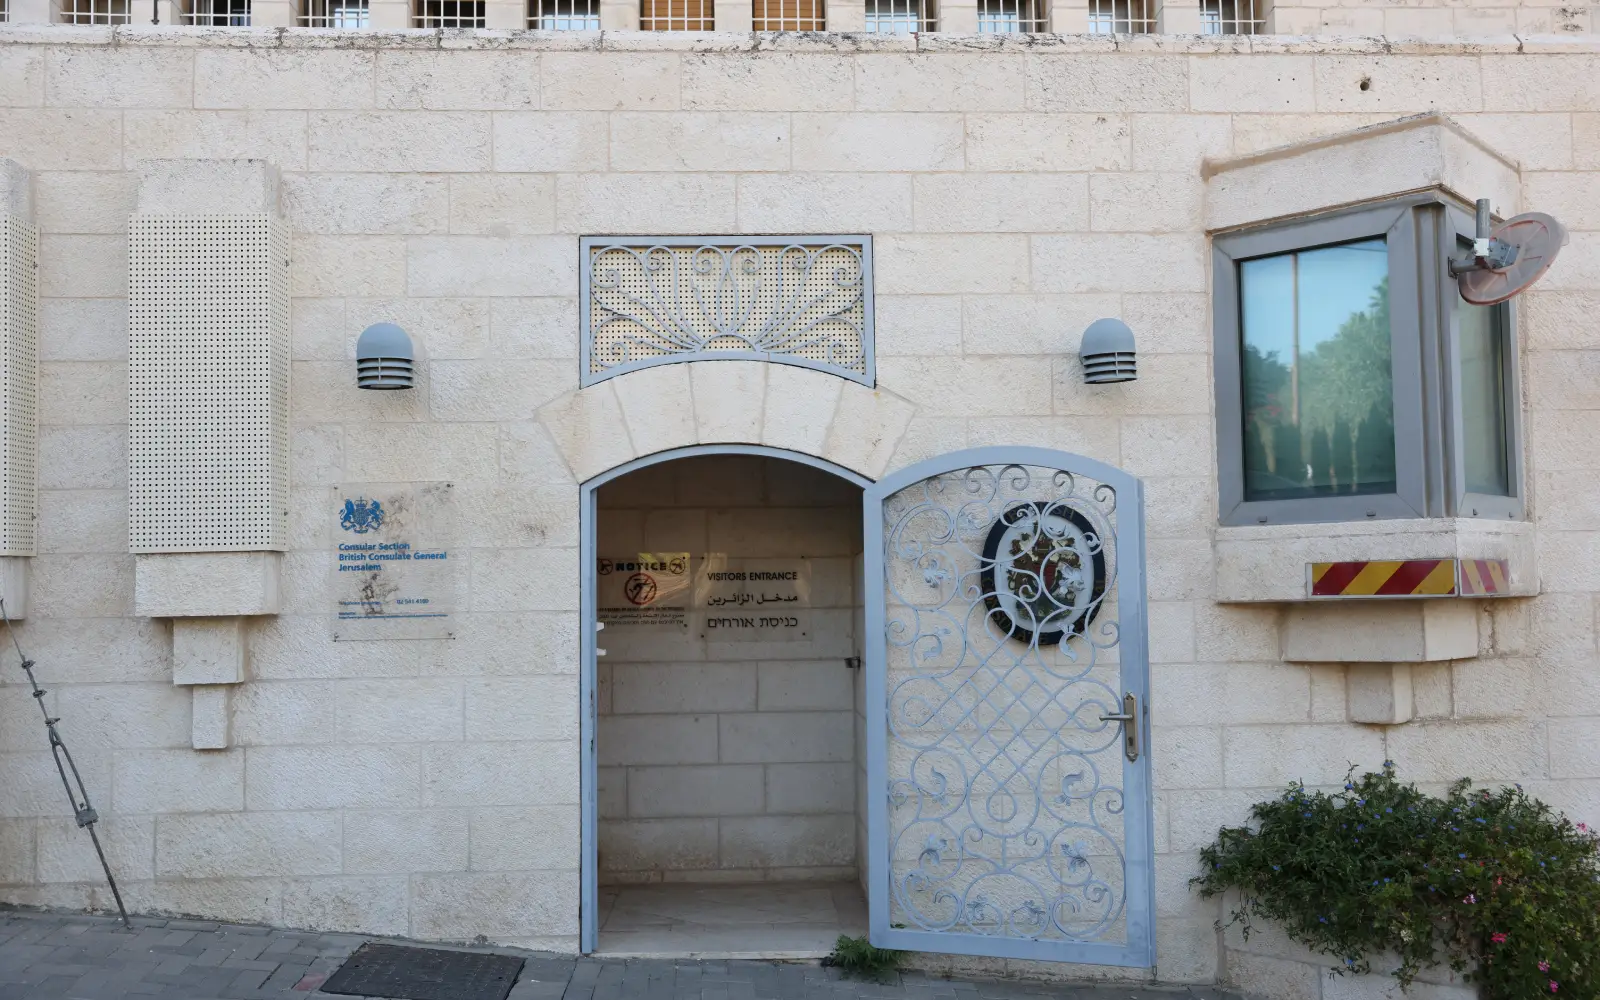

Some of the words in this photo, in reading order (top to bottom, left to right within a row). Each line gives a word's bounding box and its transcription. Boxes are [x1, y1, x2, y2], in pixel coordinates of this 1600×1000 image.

[339, 543, 376, 551] Consular
[378, 542, 410, 550] Section
[339, 553, 366, 561] British
[368, 552, 411, 561] Consulate
[414, 552, 447, 560] General
[615, 562, 667, 571] NOTICE
[707, 572, 747, 581] VISITORS
[749, 571, 798, 581] ENTRANCE
[707, 592, 754, 606] الزائرين
[756, 592, 798, 605] مدخل
[707, 617, 755, 628] אורחים
[759, 616, 798, 628] כניסת
